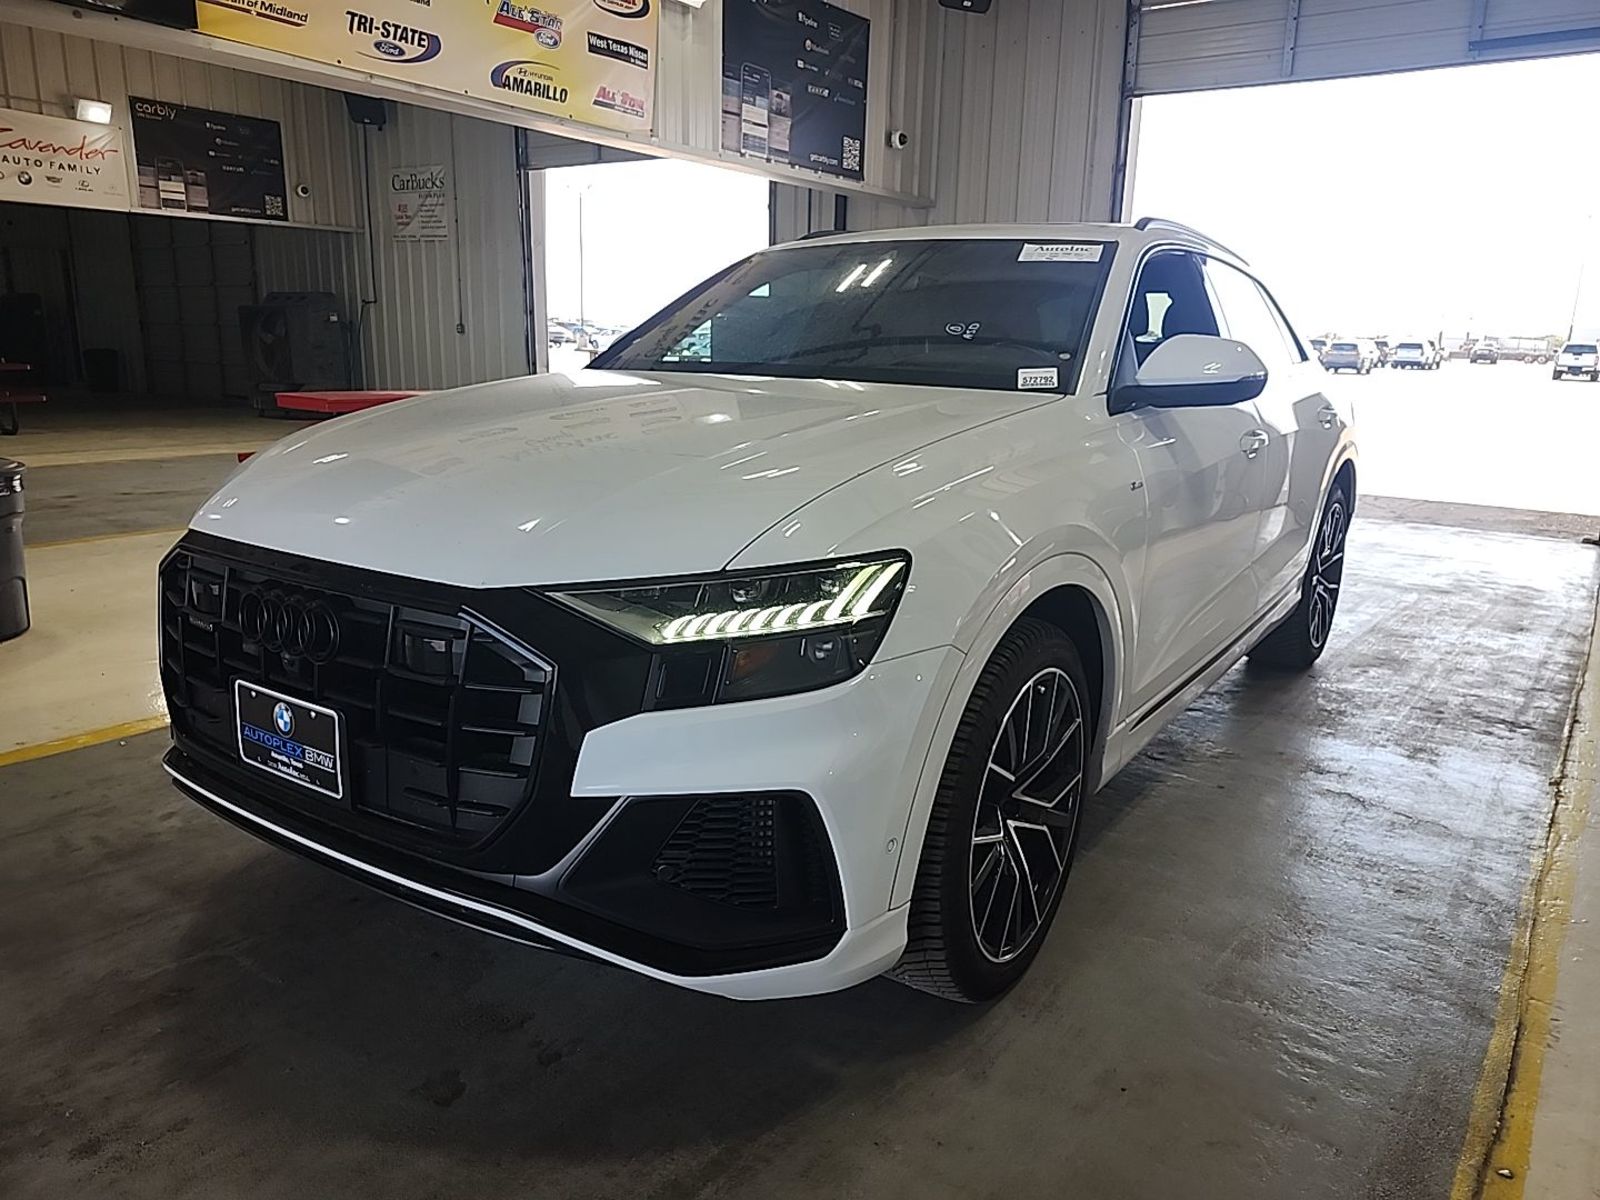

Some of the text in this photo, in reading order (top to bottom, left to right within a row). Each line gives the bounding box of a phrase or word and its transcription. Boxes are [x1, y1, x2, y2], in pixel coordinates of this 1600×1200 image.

[260, 2, 309, 22] Midland
[499, 0, 524, 18] ALL
[345, 10, 427, 48] TRI-STATE
[379, 42, 401, 56] Ford
[589, 34, 608, 49] West
[608, 40, 628, 54] Texas
[502, 75, 569, 103] AMARILLO
[135, 102, 177, 120] carbly
[2, 155, 101, 175] AUTO FAMILY
[391, 171, 445, 191] CarBucks
[1022, 375, 1054, 384] 572792
[243, 725, 334, 769] AUTOPLEX BMW
